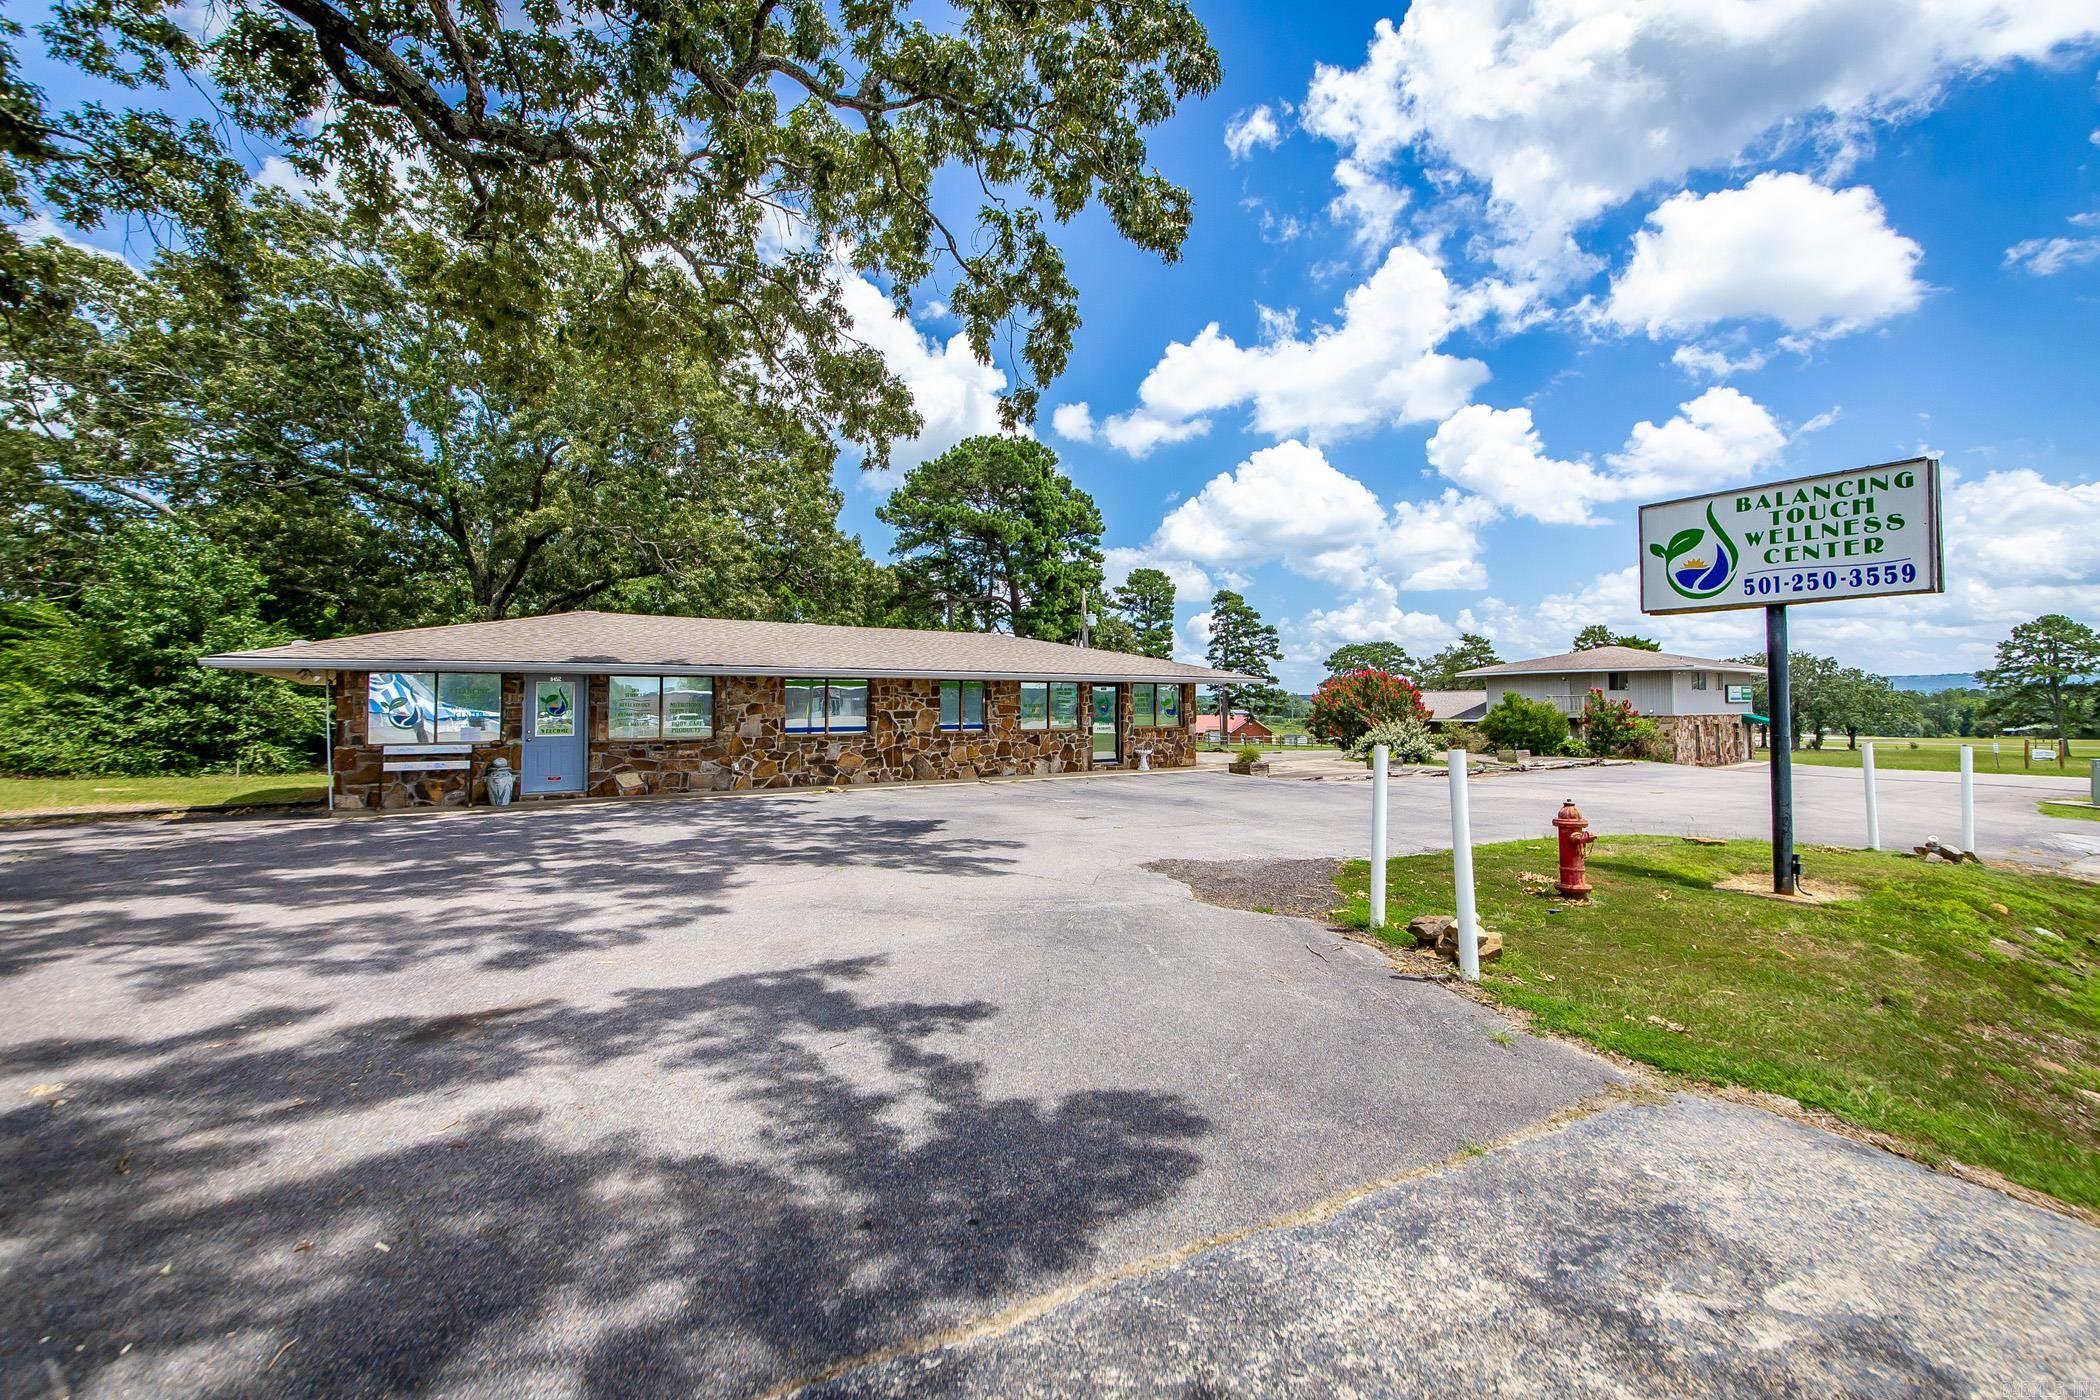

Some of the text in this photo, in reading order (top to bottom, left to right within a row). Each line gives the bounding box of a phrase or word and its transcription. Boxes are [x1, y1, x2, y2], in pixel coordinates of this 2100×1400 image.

[1736, 471, 1915, 513] BALANCING
[1768, 496, 1876, 526] TOUCH
[1744, 513, 1906, 547] WELLNESS
[1763, 536, 1885, 564] CENTER
[1743, 563, 1917, 596] 501-250-3559
